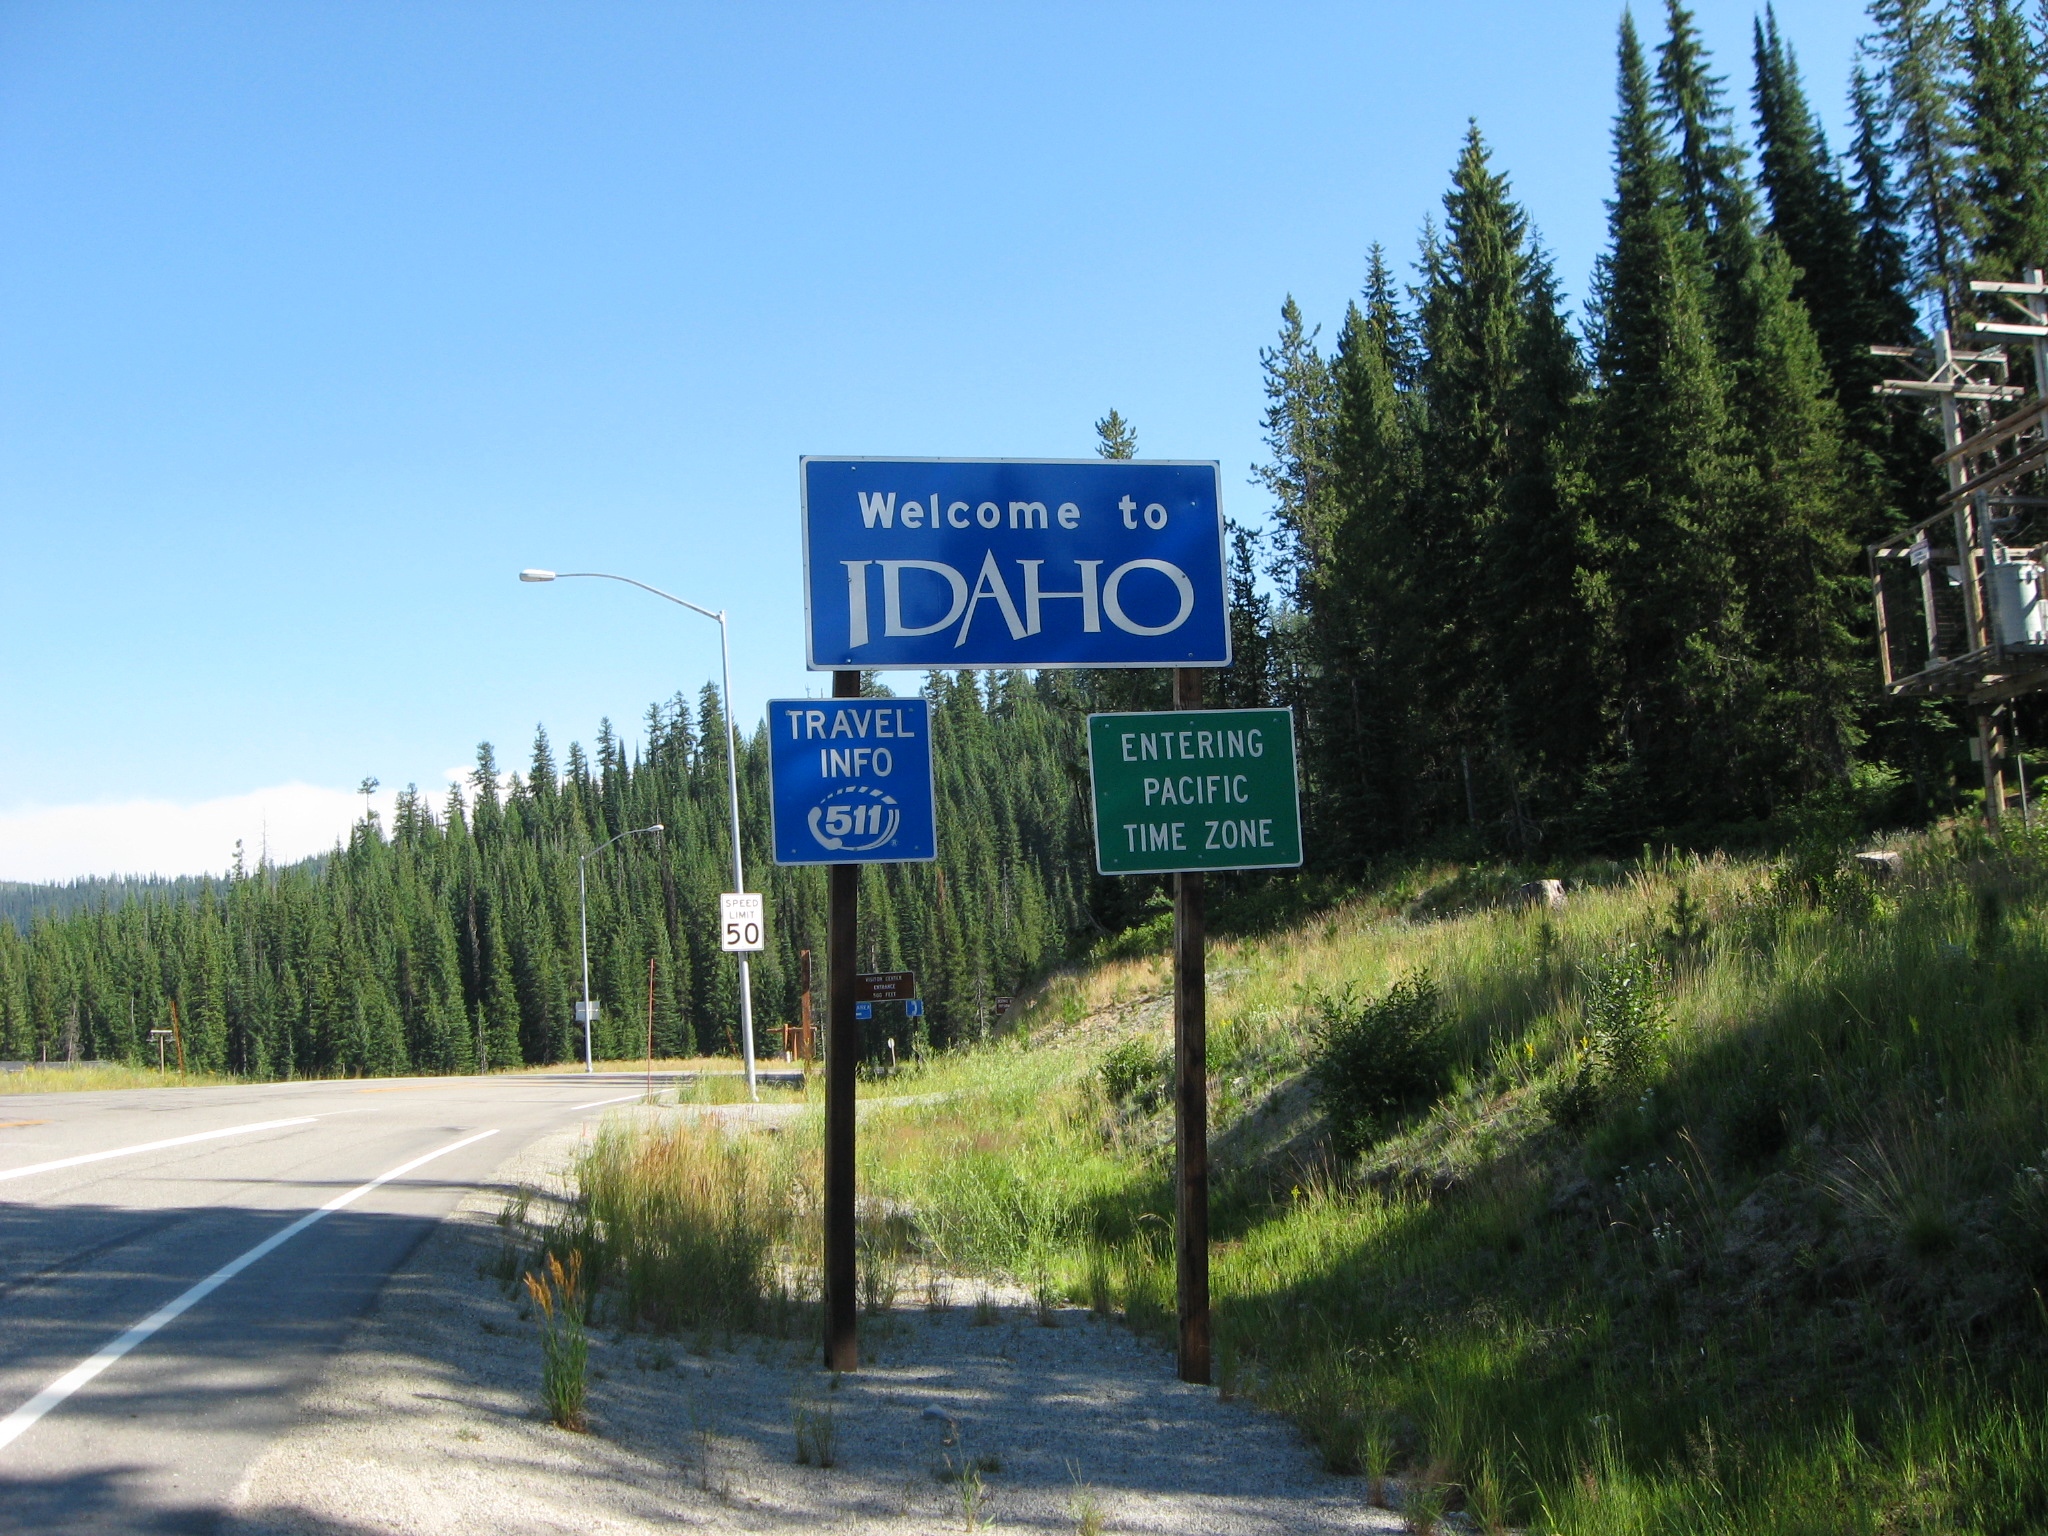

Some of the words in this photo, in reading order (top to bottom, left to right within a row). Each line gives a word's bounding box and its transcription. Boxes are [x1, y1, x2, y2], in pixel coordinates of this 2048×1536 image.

[858, 491, 1081, 530] Welcome
[1118, 494, 1168, 530] to
[839, 548, 1194, 649] IDAHO
[786, 709, 915, 740] TRAVEL
[1121, 728, 1264, 762] ENTERING
[820, 747, 893, 778] INFO
[1143, 775, 1249, 806] PACIFIC
[825, 805, 882, 836] 511
[1123, 822, 1187, 852] TIME
[1204, 819, 1274, 850] ZONE
[729, 911, 754, 919] LIMIT
[727, 923, 759, 945] 50
